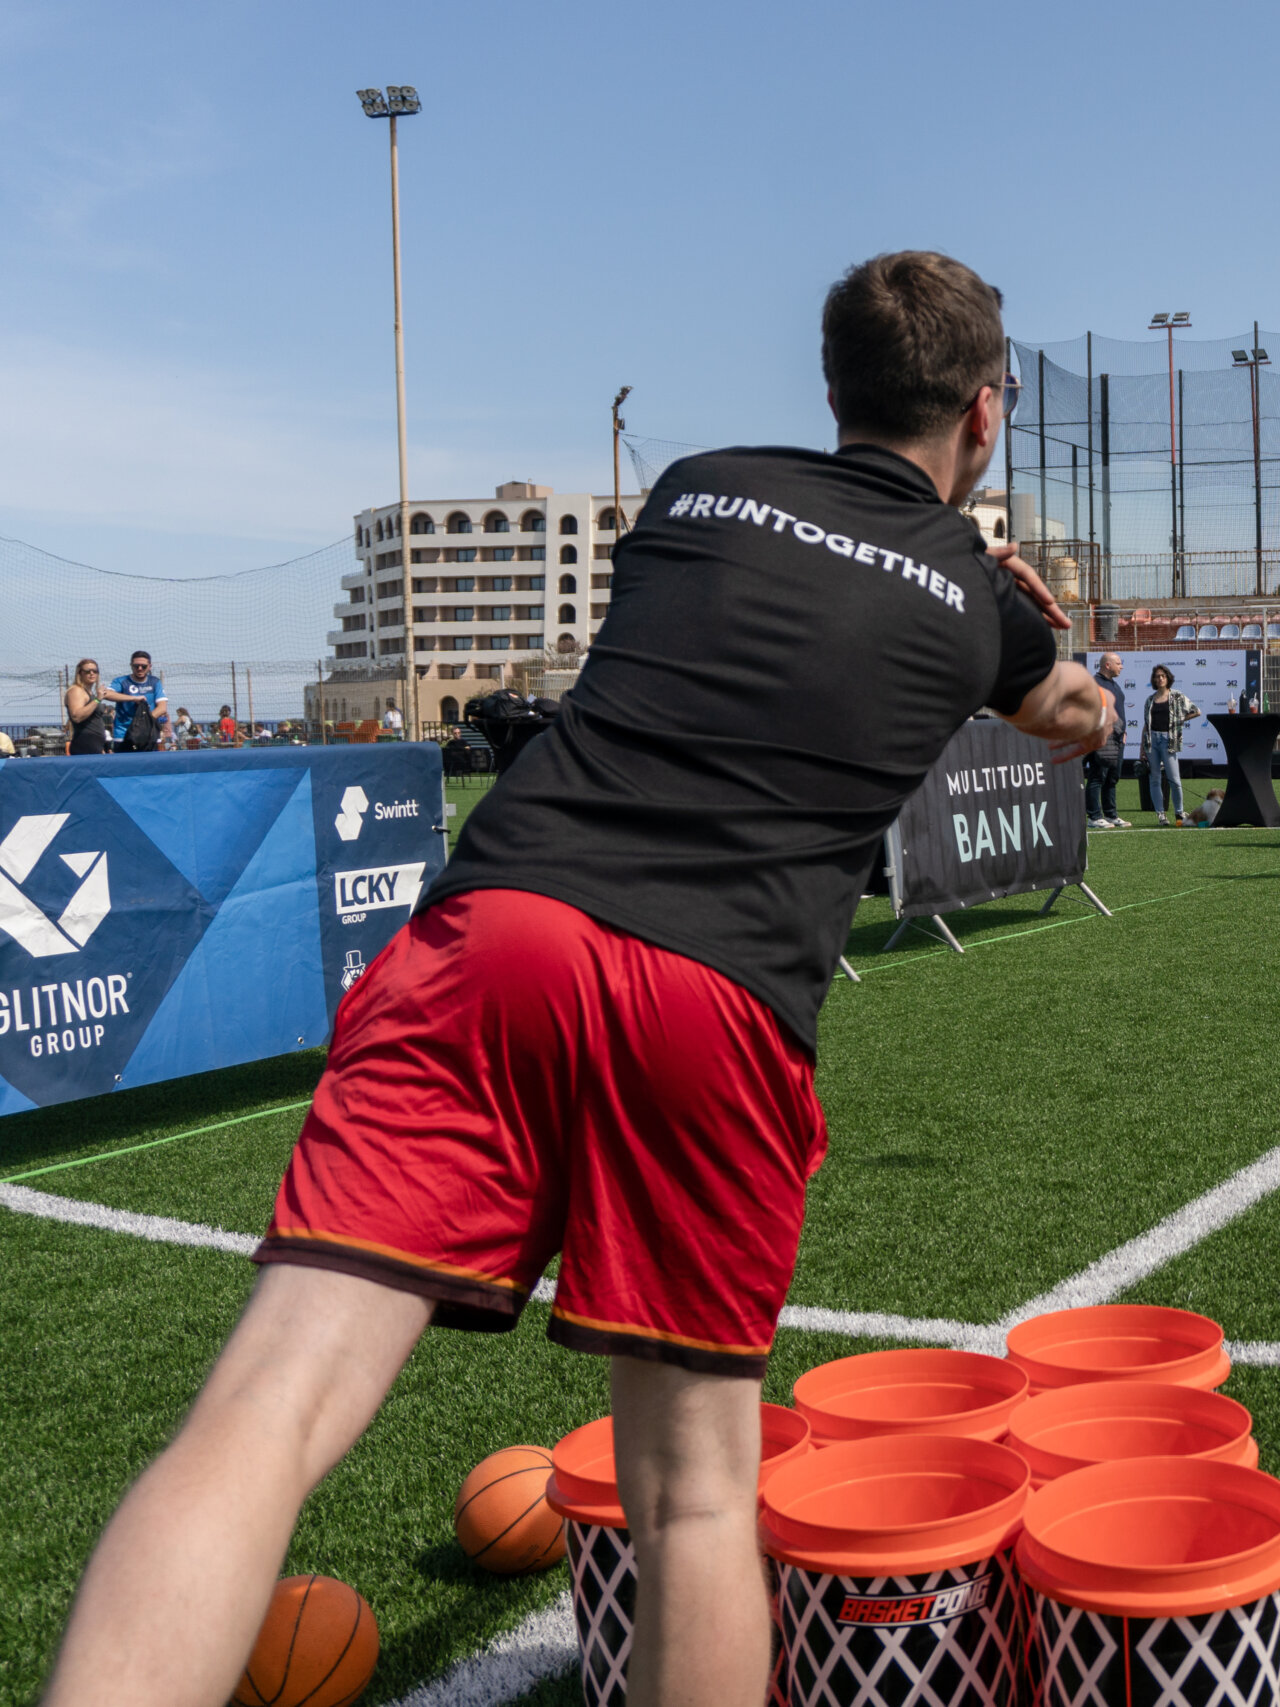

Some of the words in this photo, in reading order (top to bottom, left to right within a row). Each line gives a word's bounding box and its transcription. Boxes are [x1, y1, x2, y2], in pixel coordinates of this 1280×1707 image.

[668, 493, 966, 613] #RUNTOGETHER
[1226, 679, 1238, 687] 242
[946, 762, 1046, 796] MULTITUDE
[374, 799, 420, 820] Swintt
[952, 801, 1054, 863] BANK
[340, 871, 399, 908] LCKY
[342, 912, 367, 925] GROUP
[30, 1024, 105, 1058] GROUP
[838, 1577, 991, 1623] BASKETPONG
